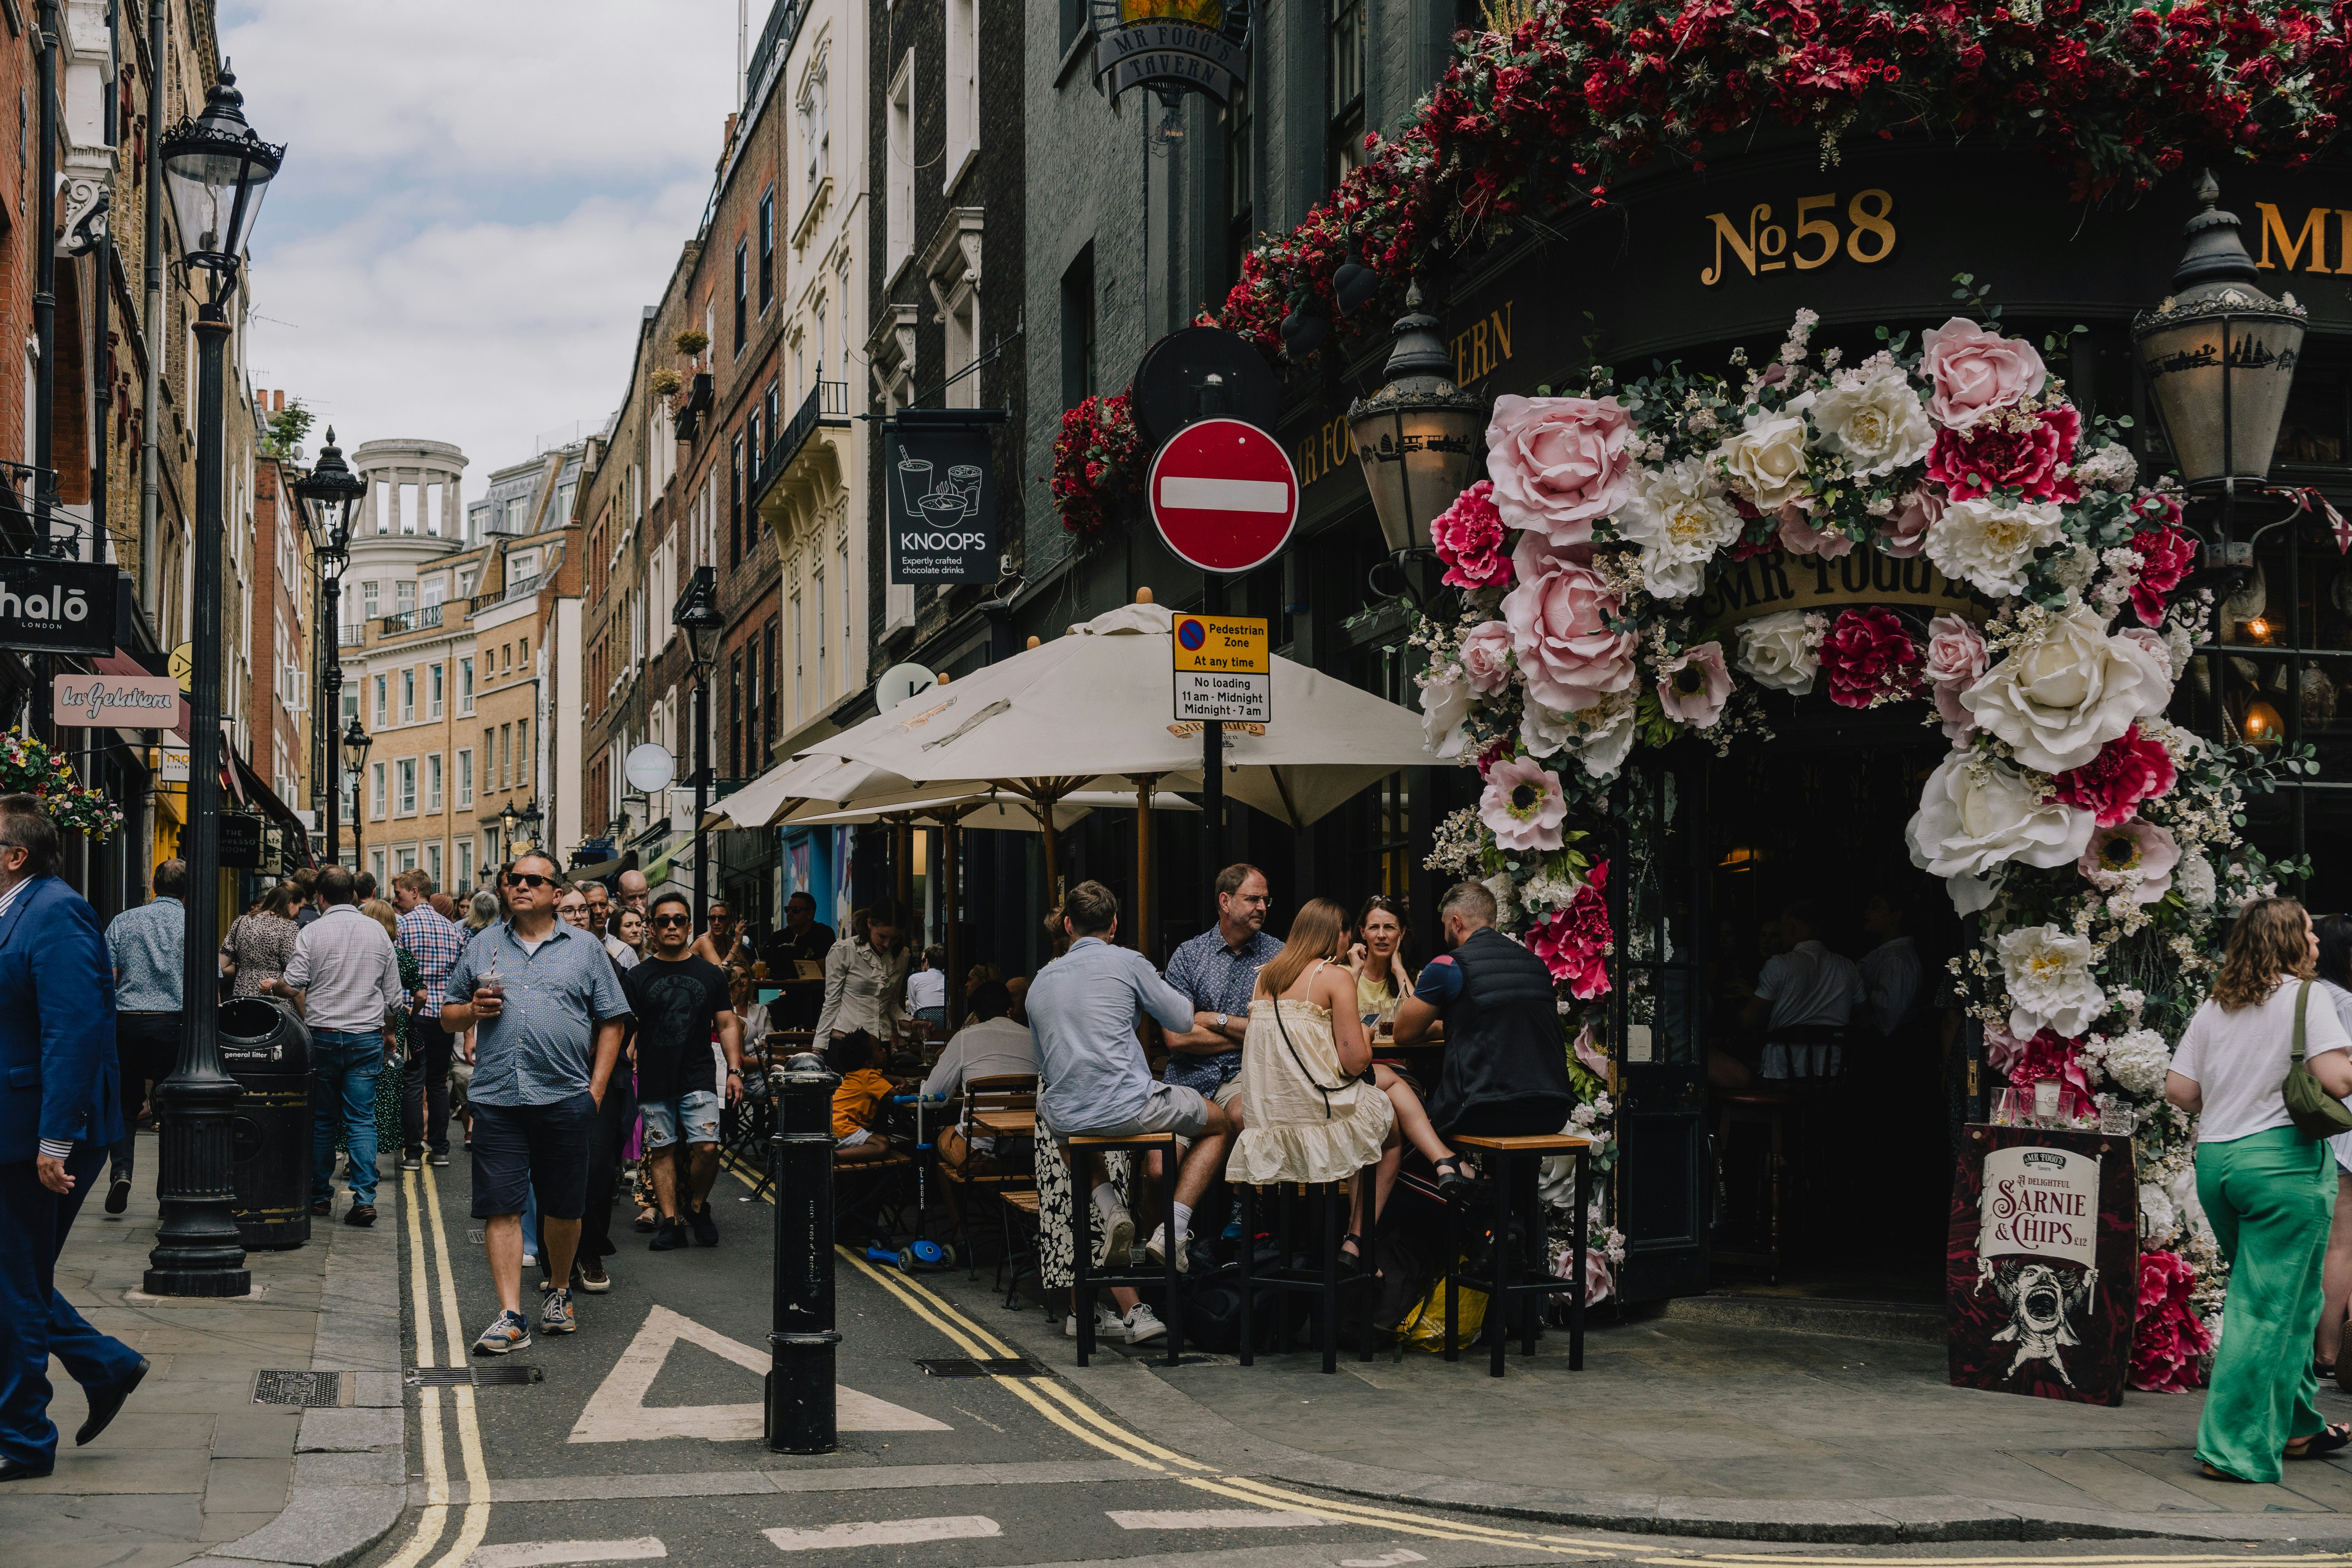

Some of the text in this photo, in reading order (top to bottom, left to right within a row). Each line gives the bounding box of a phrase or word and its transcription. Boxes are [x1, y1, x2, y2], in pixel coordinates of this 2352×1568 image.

[1113, 27, 1232, 61] MR FOGG'S
[1129, 54, 1218, 83] TAVERN
[902, 533, 985, 550] KNOOPS
[902, 557, 933, 566] Expertly
[1209, 624, 1264, 635] Pedestrian
[1224, 637, 1249, 647] Zone
[1194, 656, 1254, 668] At any time
[1195, 677, 1250, 690] No loading
[1218, 692, 1263, 704] Midnight
[1185, 704, 1230, 716] Midnight
[2025, 1153, 2063, 1164] MR FOGG'S
[2017, 1175, 2070, 1188] A DELIGHTFUL
[1993, 1180, 2086, 1219] SARNIE
[1995, 1212, 2087, 1250] & CHIPS £12
